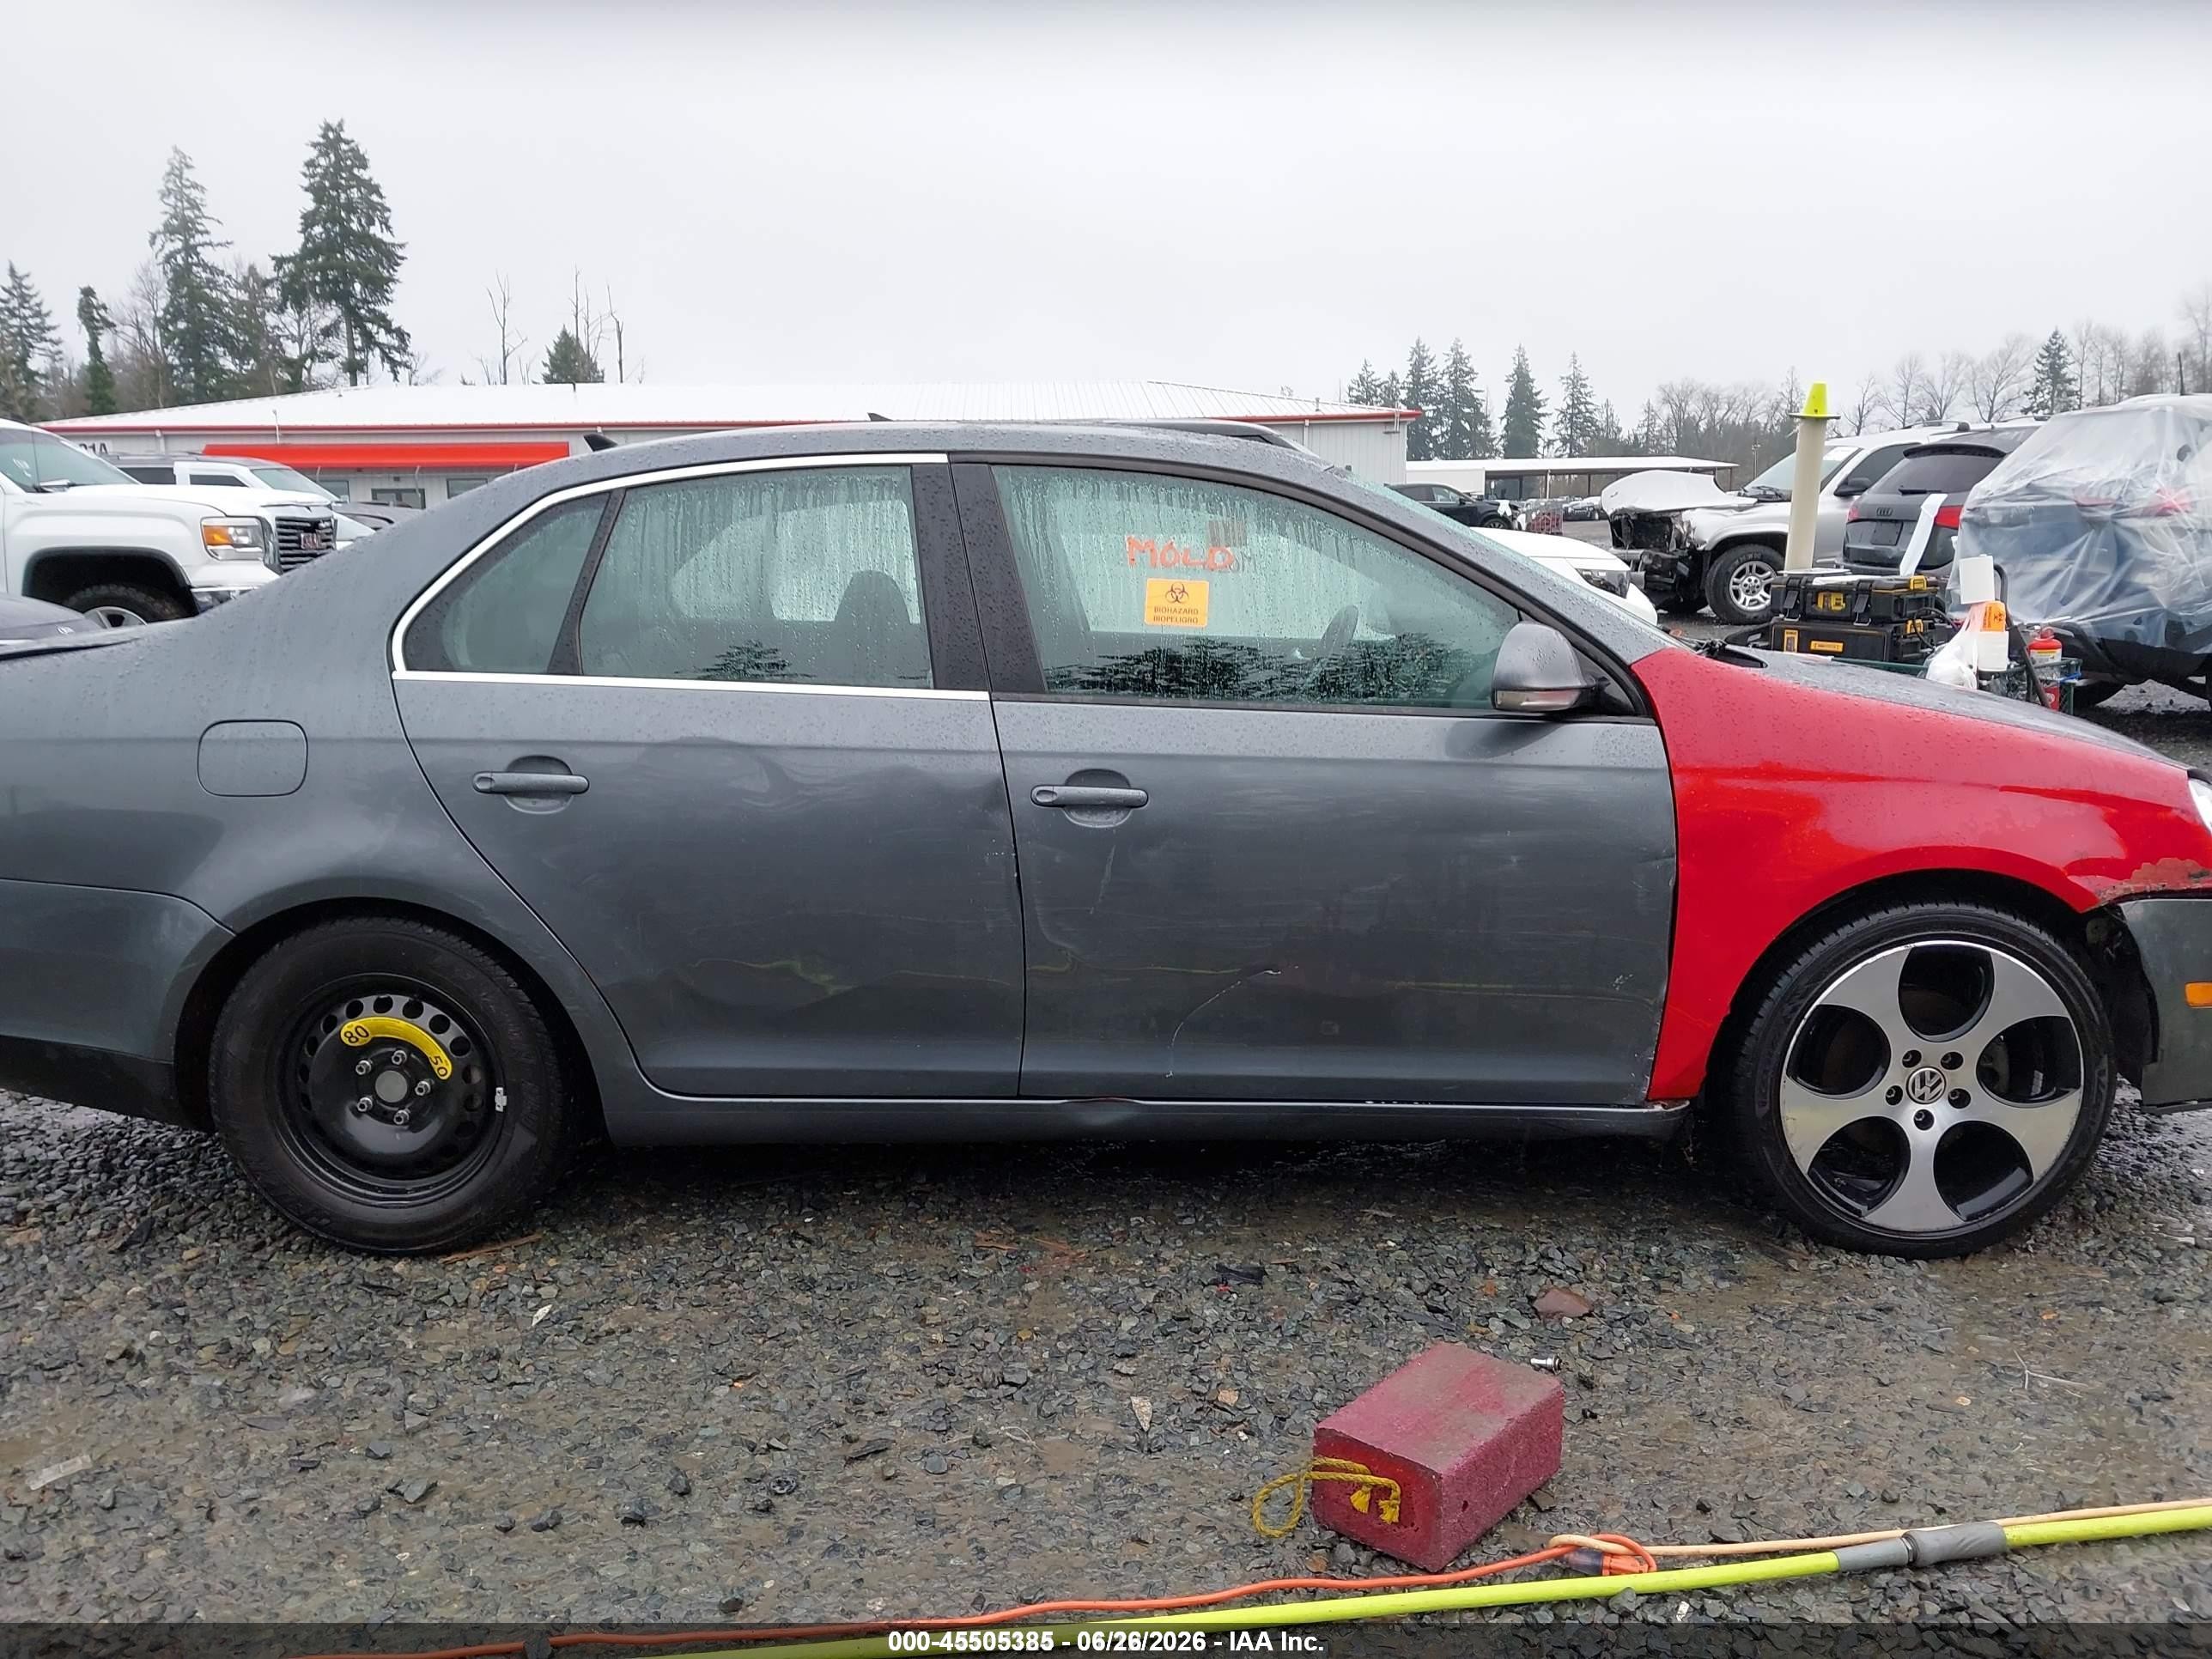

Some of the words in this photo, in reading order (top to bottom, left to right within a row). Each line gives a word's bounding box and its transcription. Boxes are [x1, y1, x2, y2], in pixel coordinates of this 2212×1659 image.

[1126, 535, 1235, 571] MOLD
[1153, 605, 1200, 616] BIOHAZARD
[1153, 615, 1199, 624] BIOPELIGRO
[343, 1025, 370, 1044] 80
[429, 1055, 448, 1077] 50
[1910, 1069, 1944, 1103] VW
